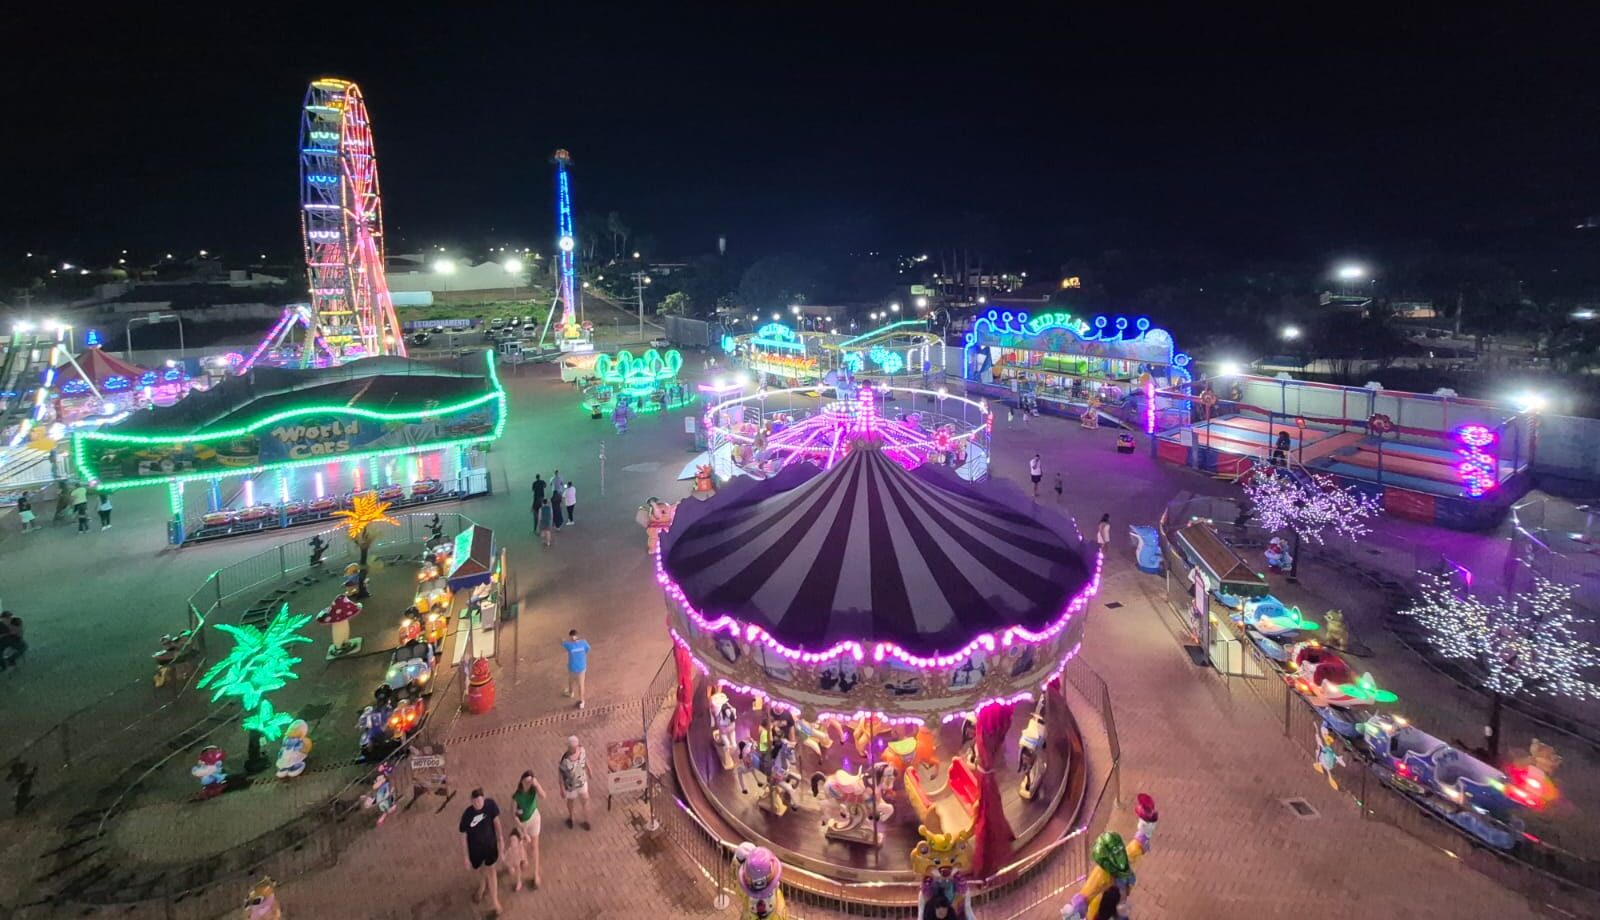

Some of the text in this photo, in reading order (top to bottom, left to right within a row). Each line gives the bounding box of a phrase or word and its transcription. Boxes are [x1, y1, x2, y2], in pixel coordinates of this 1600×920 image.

[1029, 313, 1091, 335] KID PLAY
[271, 420, 358, 442] World
[288, 440, 349, 459] Cars
